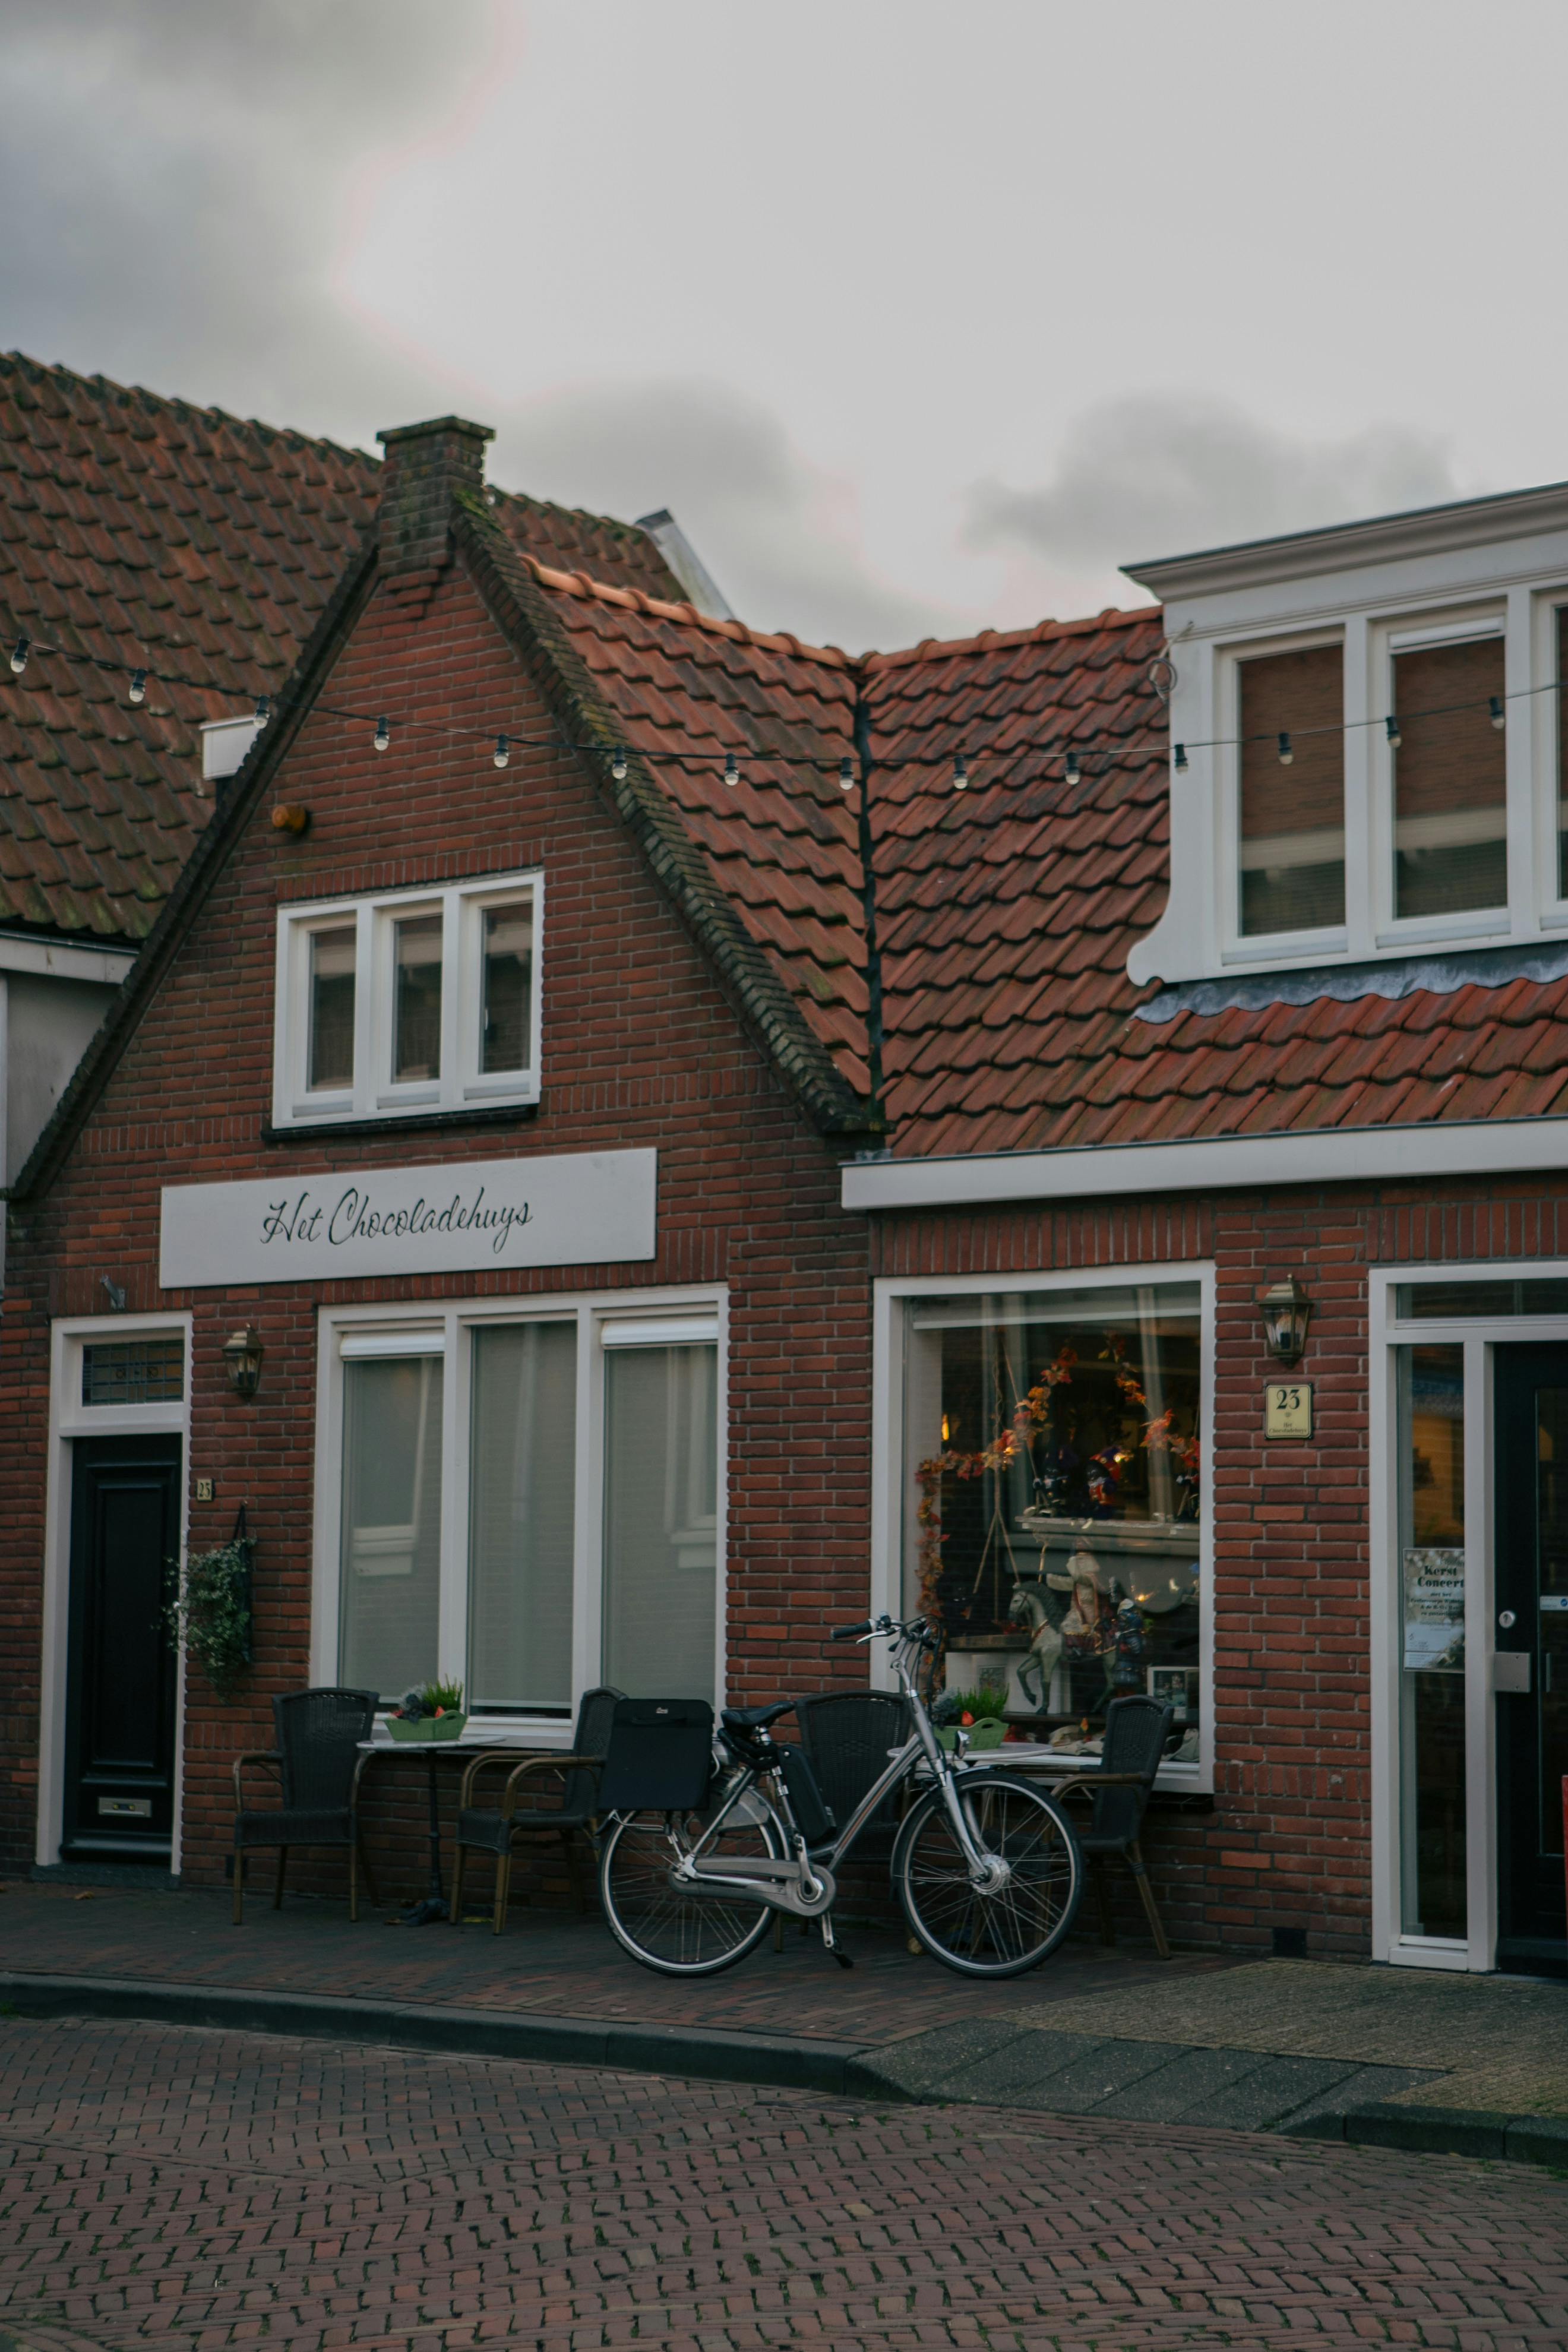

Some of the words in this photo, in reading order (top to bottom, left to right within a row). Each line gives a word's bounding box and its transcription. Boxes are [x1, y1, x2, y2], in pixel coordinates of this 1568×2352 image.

[260, 1193, 324, 1244] Het
[328, 1186, 533, 1254] Chocoladehuys
[1276, 1389, 1301, 1409] 23
[200, 1482, 210, 1498] 25
[1424, 1565, 1457, 1576] Kerst
[1417, 1576, 1464, 1588] Concert
